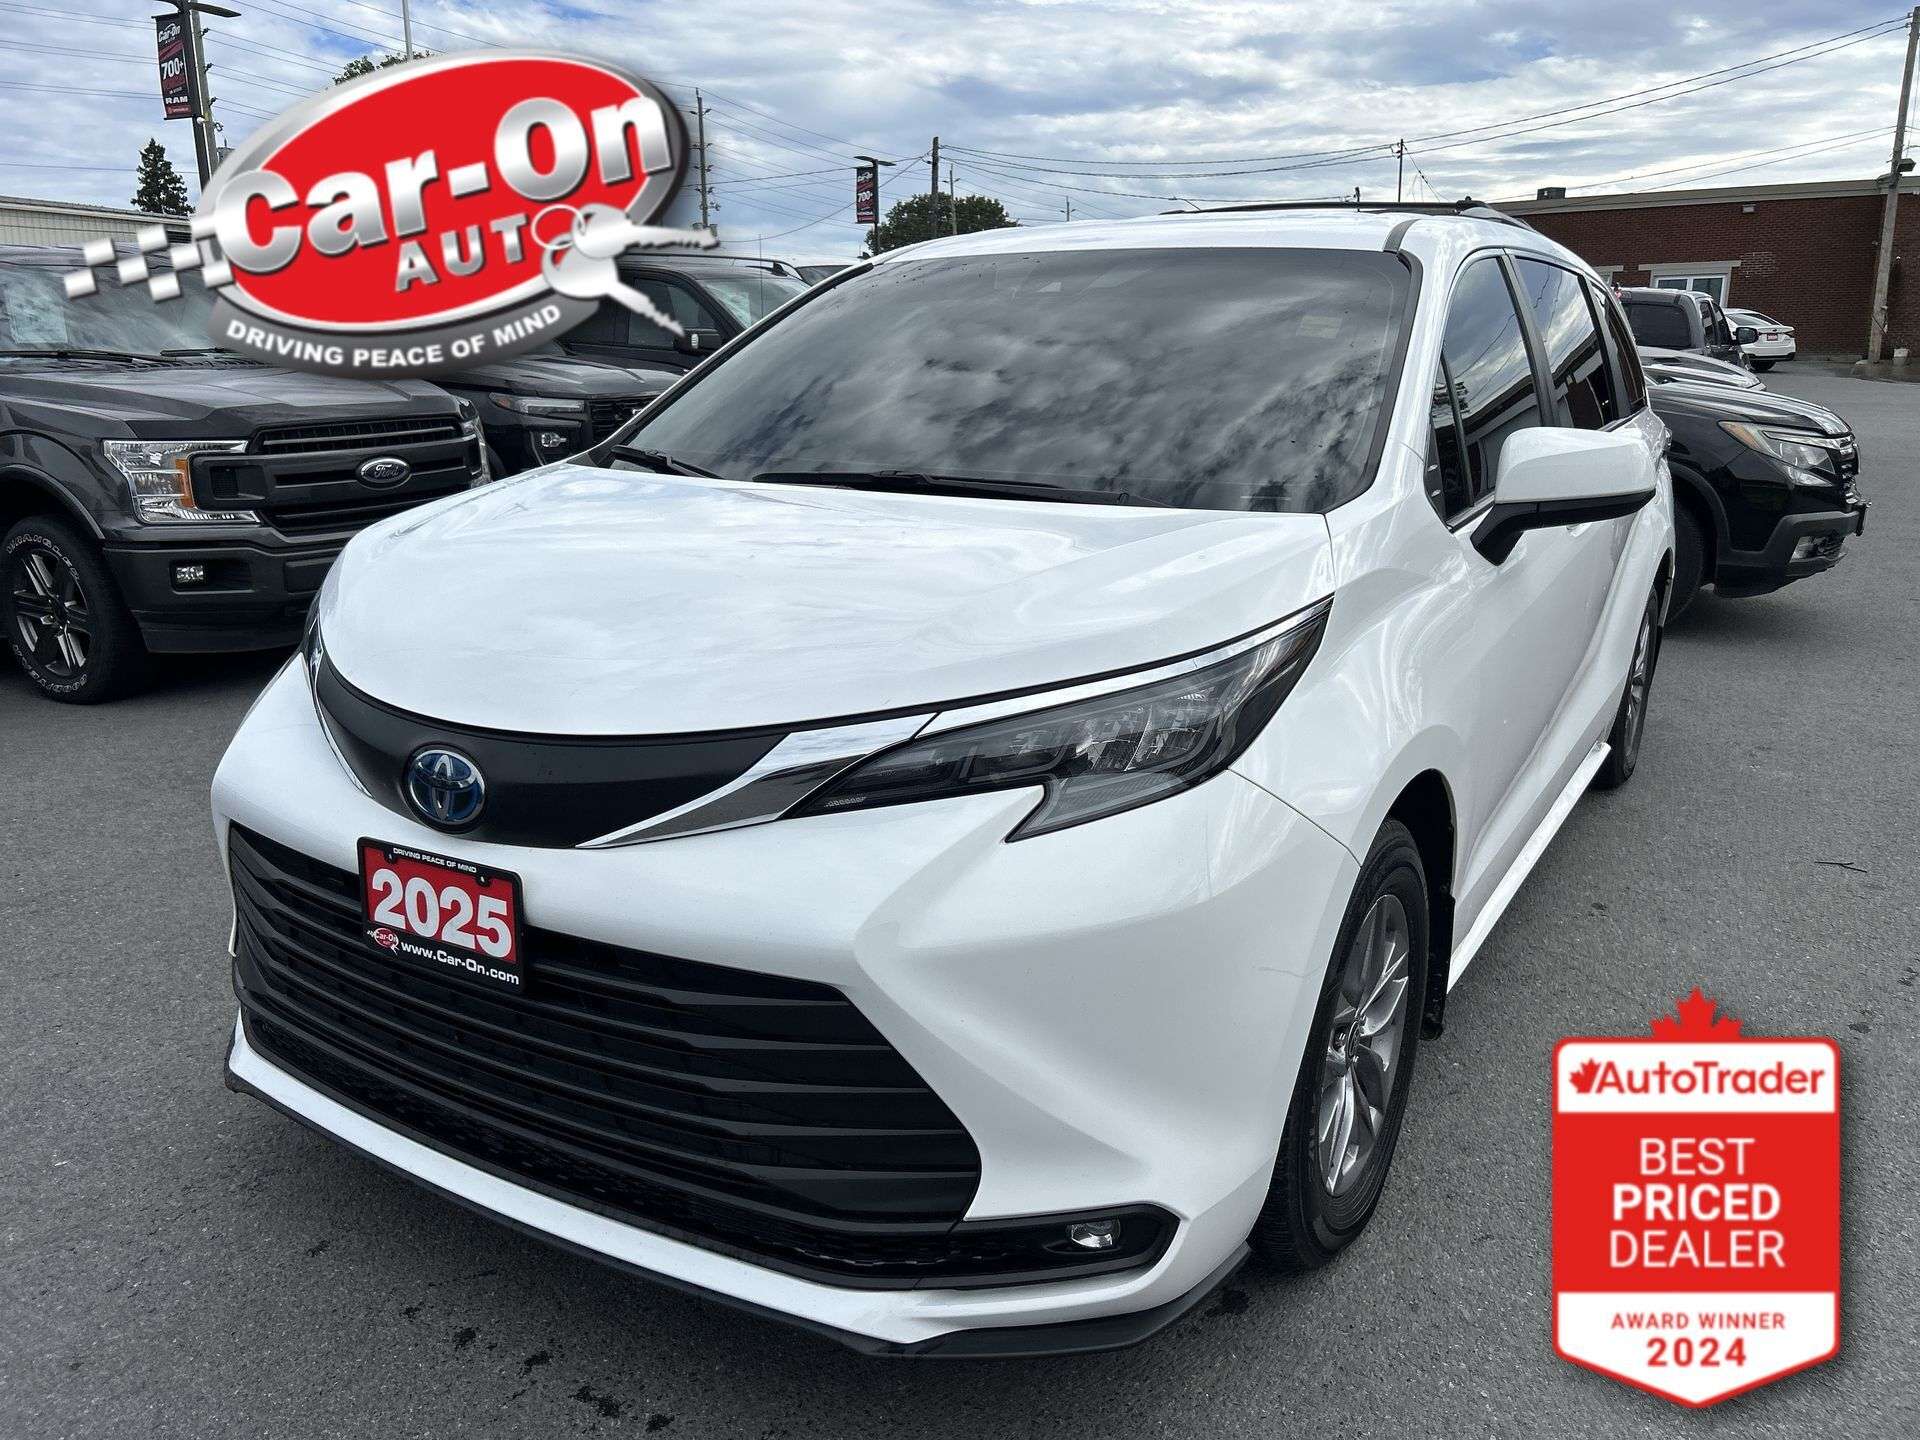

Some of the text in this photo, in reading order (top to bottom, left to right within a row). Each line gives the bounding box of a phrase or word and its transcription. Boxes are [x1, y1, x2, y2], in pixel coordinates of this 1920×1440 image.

[158, 25, 181, 43] Car-On
[161, 57, 184, 81] 700+
[165, 95, 188, 105] RAM
[393, 847, 477, 874] DRIVING PEACE OF MIND
[372, 868, 512, 959] 2025
[375, 931, 398, 942] Car-On
[400, 941, 520, 985] www.Car-On.com
